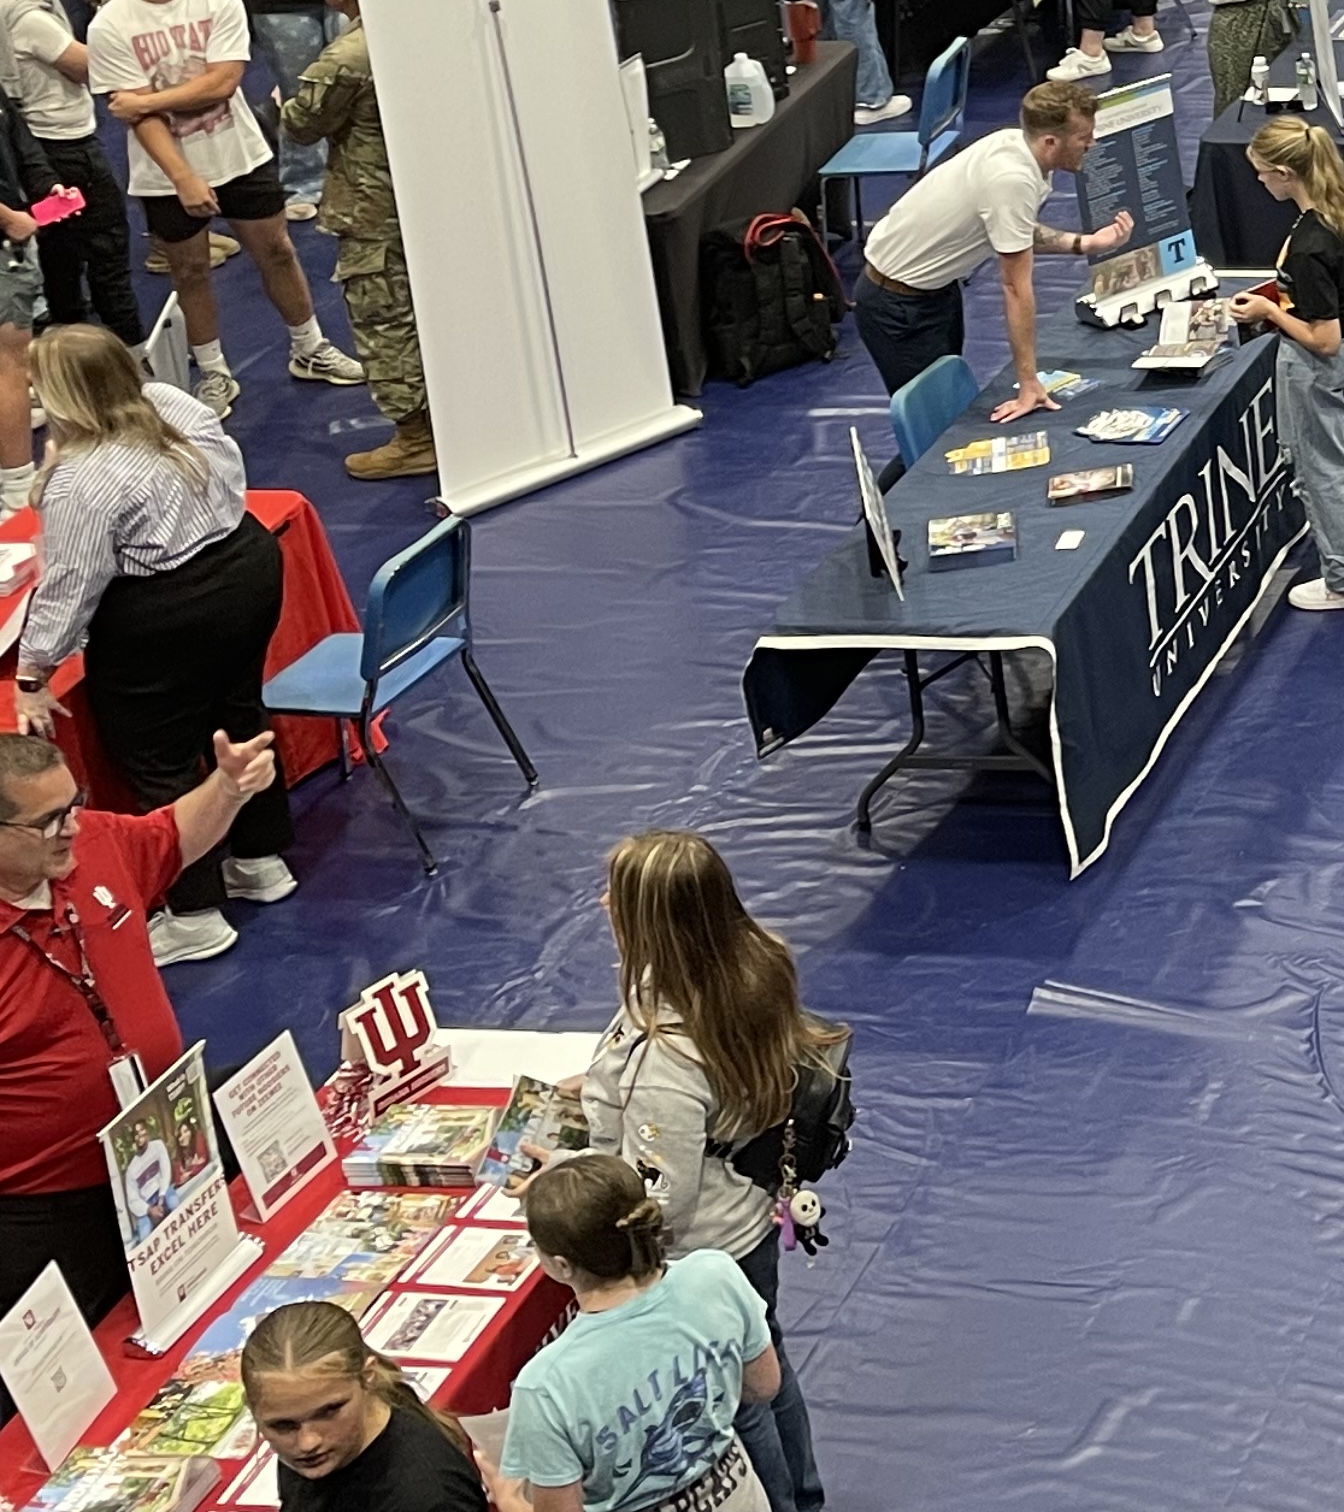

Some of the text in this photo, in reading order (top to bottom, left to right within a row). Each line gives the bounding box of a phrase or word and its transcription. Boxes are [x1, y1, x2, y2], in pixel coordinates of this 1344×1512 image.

[1116, 105, 1163, 127] UNIVERSITY
[1168, 238, 1186, 263] T
[1128, 376, 1286, 652] TRINE
[1152, 482, 1288, 698] UNIVERSITY
[354, 980, 431, 1078] IU
[228, 1050, 281, 1100] GET CONNECTED
[150, 1201, 219, 1276] EXCEL HERE
[163, 1173, 225, 1242] TRANSFERS
[596, 1368, 664, 1451] SALT
